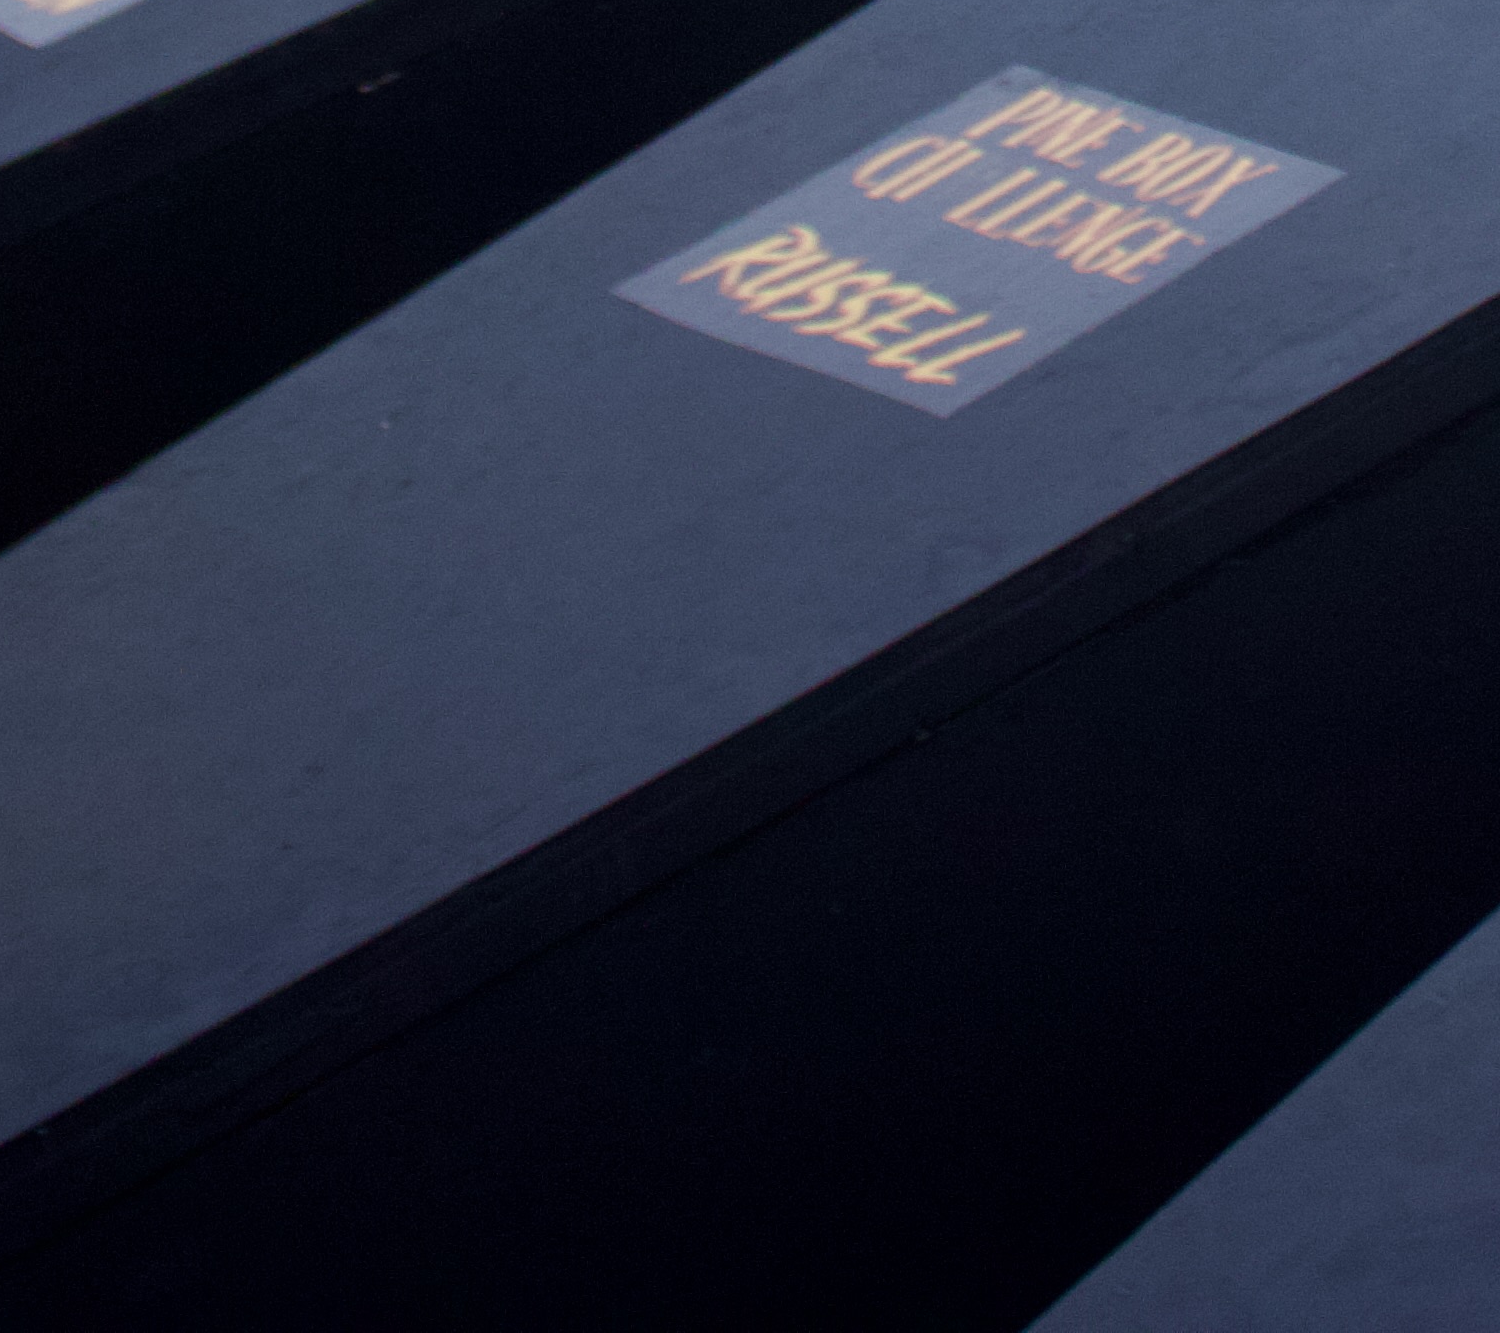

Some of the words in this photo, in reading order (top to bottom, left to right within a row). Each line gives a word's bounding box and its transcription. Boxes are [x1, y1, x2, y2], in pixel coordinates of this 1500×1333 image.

[851, 135, 1205, 285] CHLLENGE
[964, 87, 1146, 169] PINE
[1095, 132, 1279, 218] BOX
[677, 224, 1027, 385] RUSSELL
